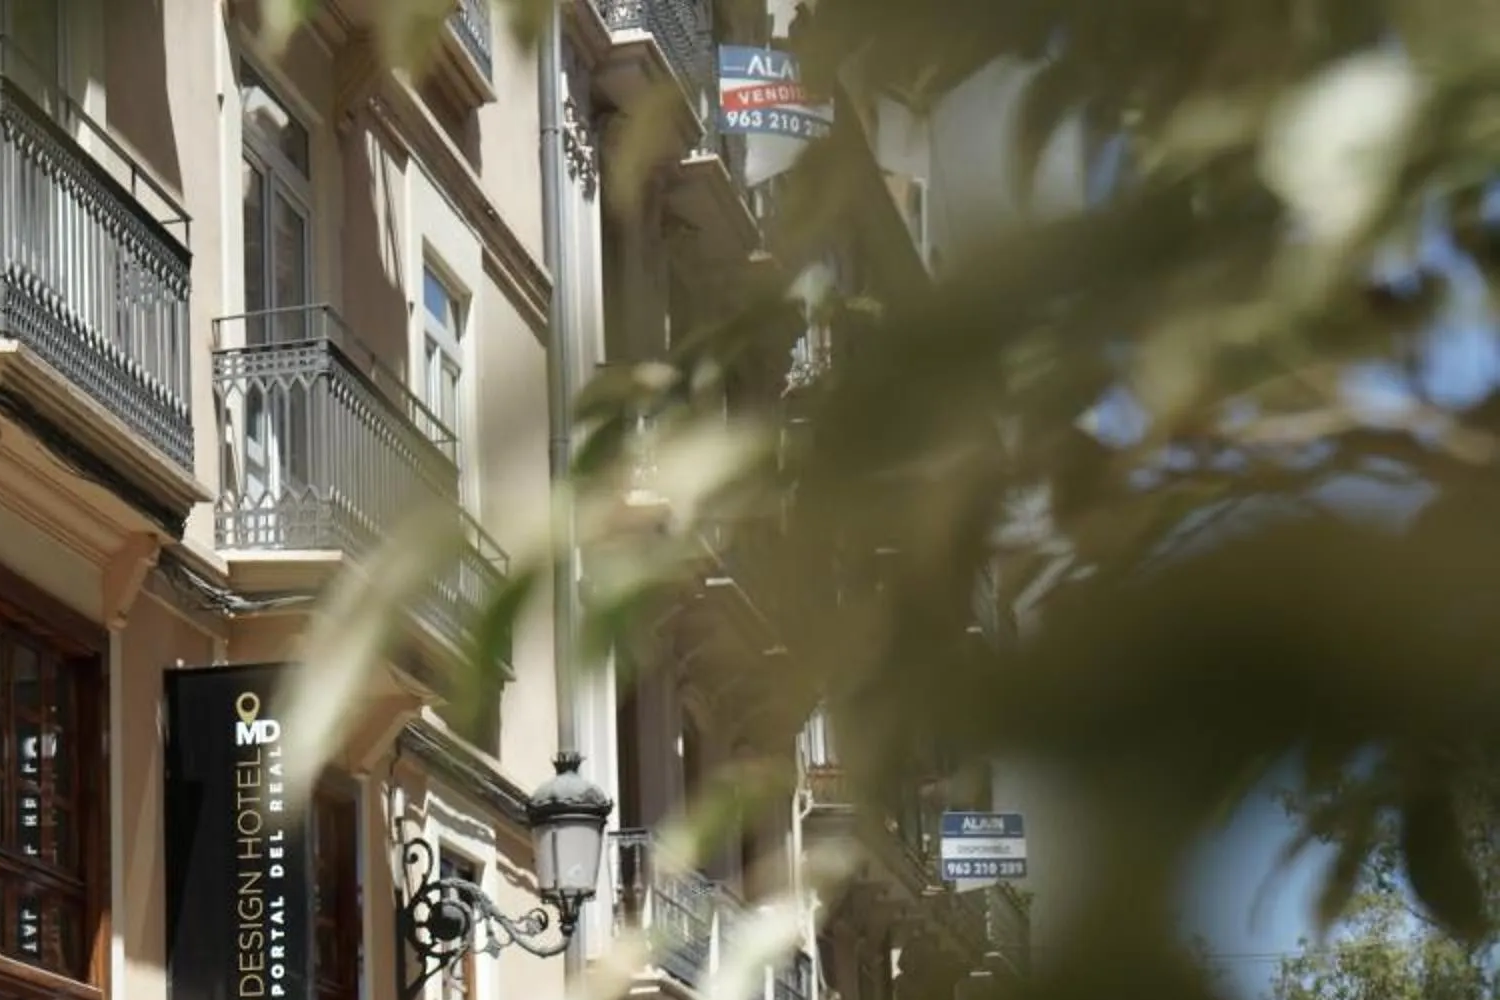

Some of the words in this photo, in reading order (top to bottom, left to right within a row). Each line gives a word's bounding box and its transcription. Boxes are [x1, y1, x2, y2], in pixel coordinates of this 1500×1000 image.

[726, 110, 763, 127] 963
[769, 112, 800, 132] 210
[236, 719, 281, 746] MD
[237, 748, 262, 860] HOTEL
[269, 745, 284, 812] REAL
[269, 829, 284, 878] DEL
[947, 861, 971, 876] 963
[238, 871, 265, 998] DESIGN
[270, 895, 285, 997] PORTAL
